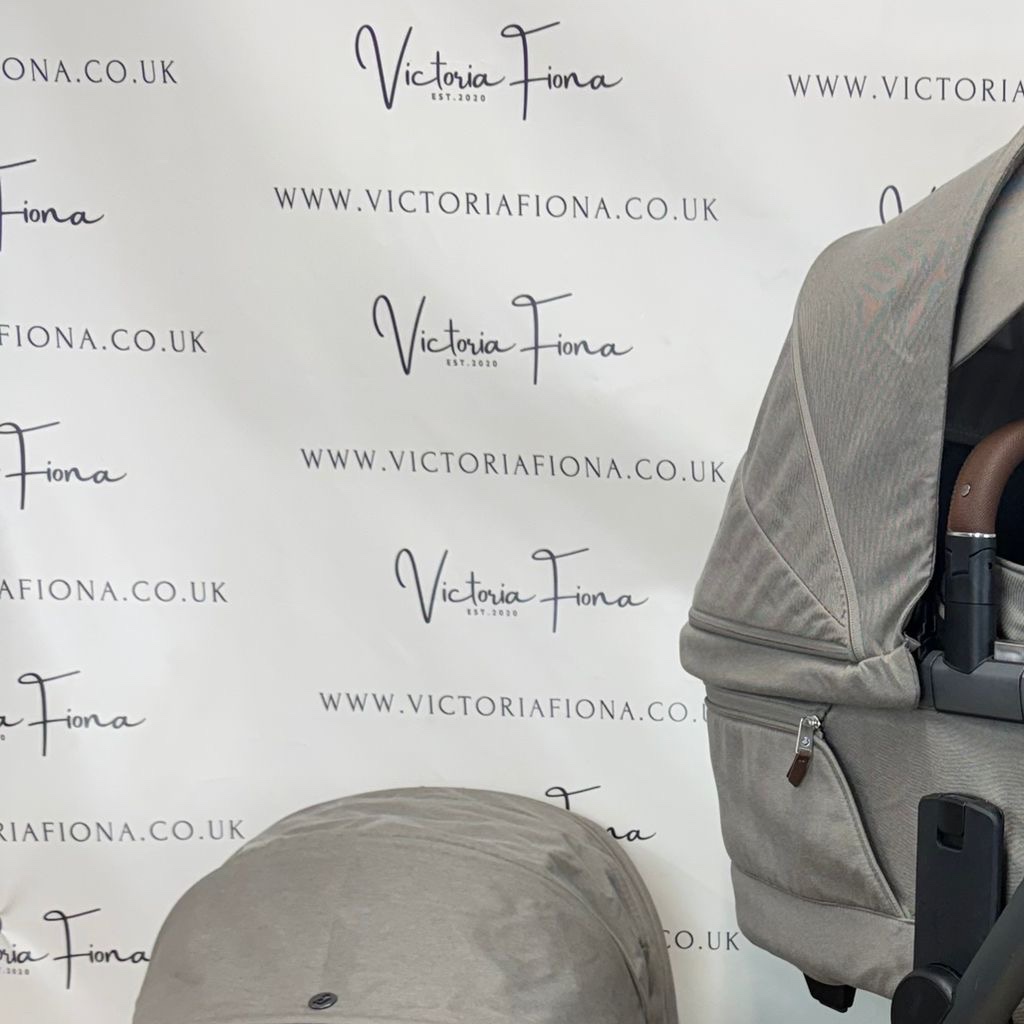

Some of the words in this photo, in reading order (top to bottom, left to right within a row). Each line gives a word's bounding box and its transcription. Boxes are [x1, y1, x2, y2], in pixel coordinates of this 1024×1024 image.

[2, 57, 178, 84] ONA.CO.UK
[354, 24, 506, 110] Victoria
[500, 21, 623, 121] Fiona
[431, 92, 486, 102] EST.2020
[273, 187, 719, 222] WWW.VICTORIAFIONA.CO.UK
[372, 294, 517, 376] Victoria
[511, 293, 634, 386] Fiona
[446, 359, 497, 367] EST.2020
[0, 421, 127, 510] Fiona
[300, 448, 726, 483] WWW.VICTORIAFIONA.CO.UK
[394, 548, 536, 624] Victoria
[531, 548, 648, 634] Fiona
[467, 608, 518, 616] EST.2020
[17, 670, 146, 757] Fiona
[44, 908, 150, 990] Fiona
